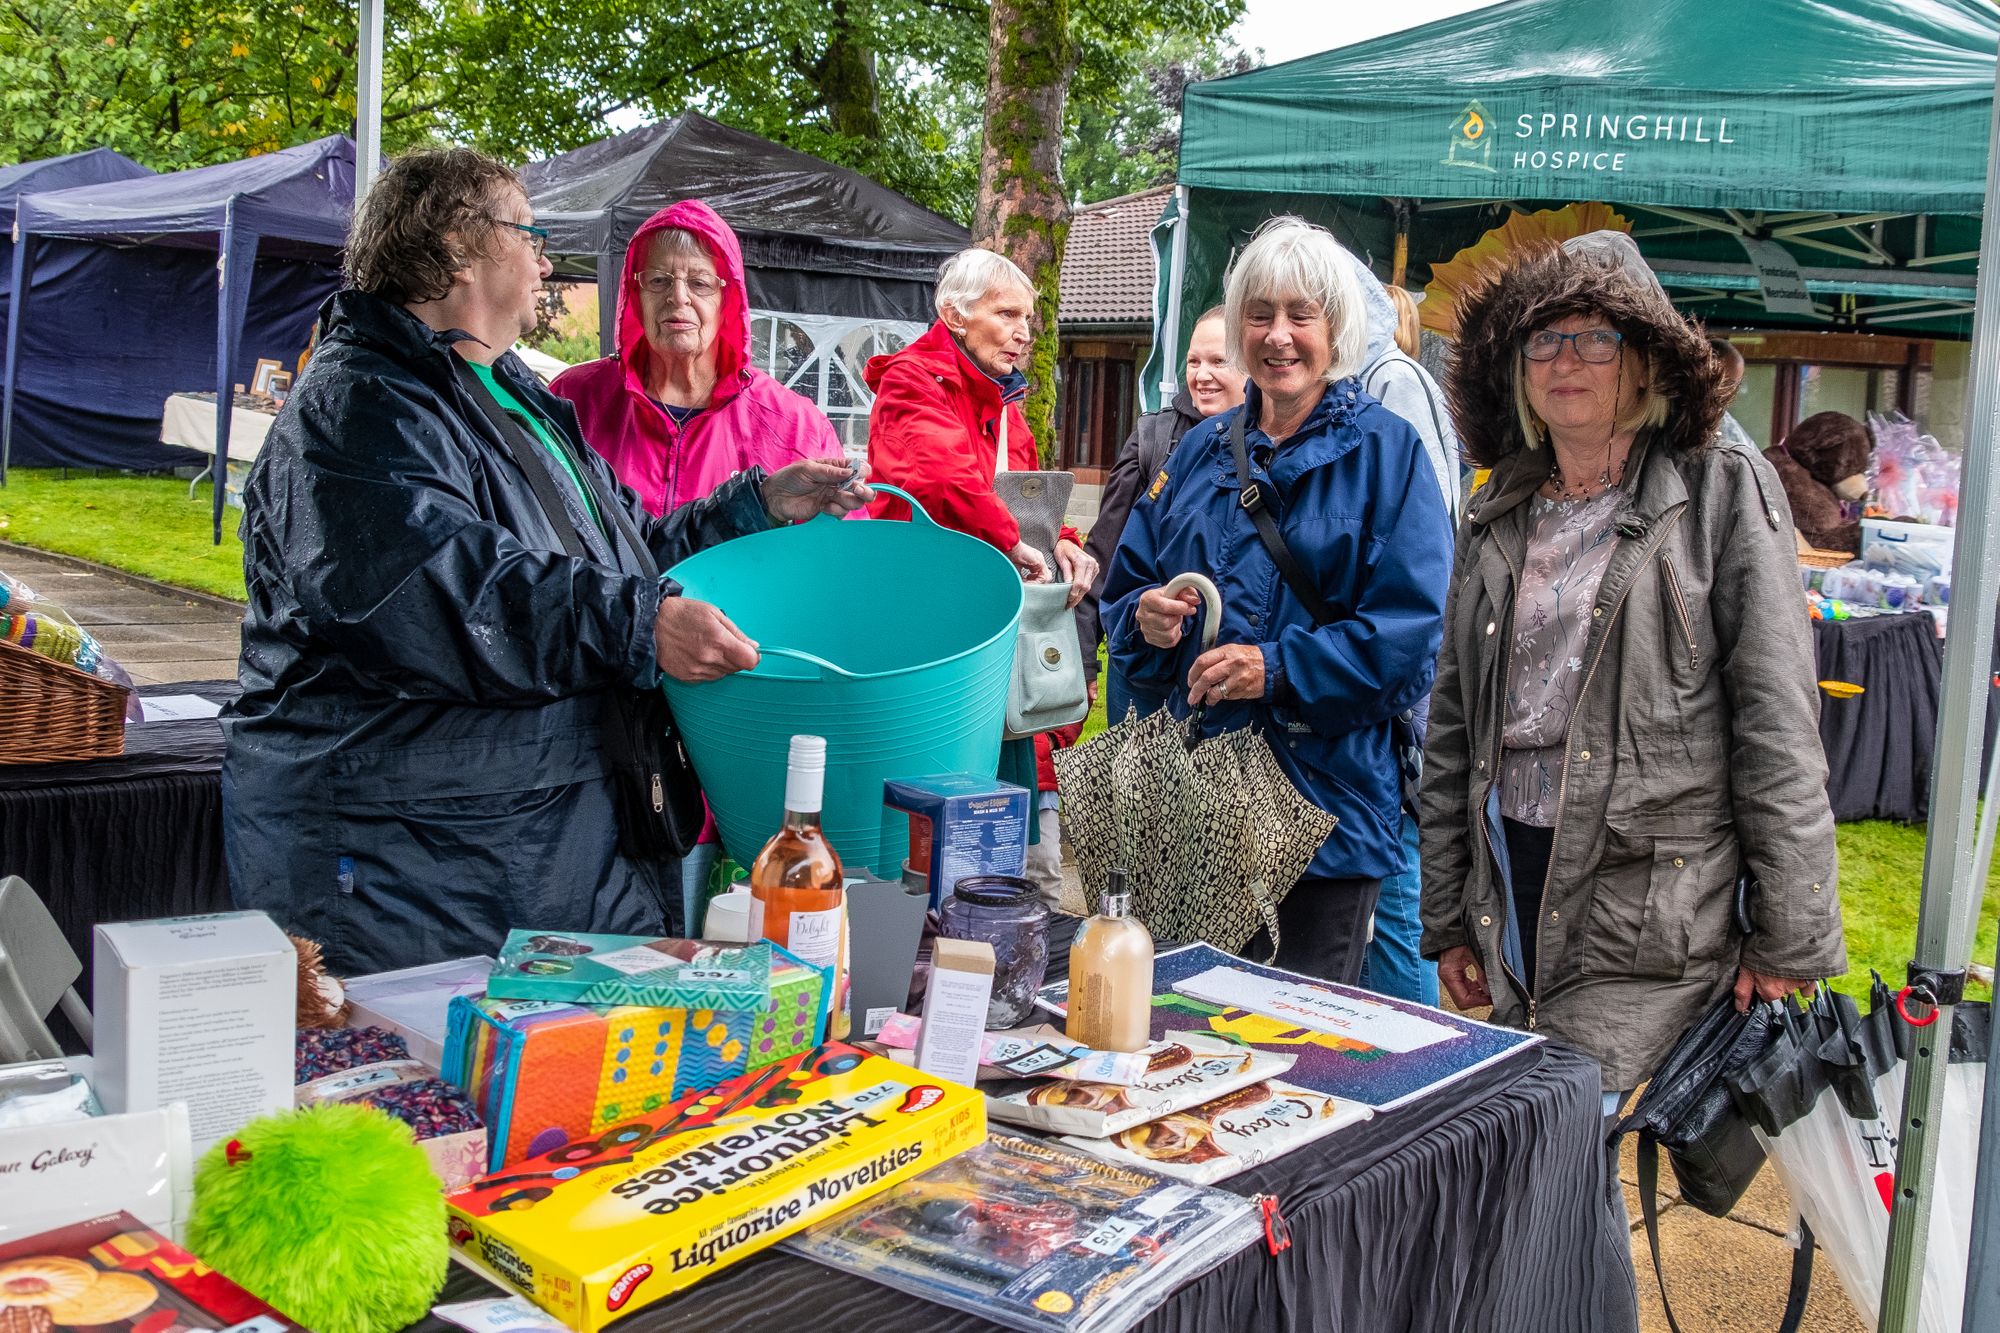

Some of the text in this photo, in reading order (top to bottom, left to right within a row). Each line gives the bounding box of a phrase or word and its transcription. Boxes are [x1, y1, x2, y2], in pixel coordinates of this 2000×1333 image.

[1515, 113, 1735, 143] SPRINGHILL
[1513, 151, 1626, 171] HOSPICE
[692, 970, 738, 979] 765
[1268, 999, 1352, 1029] Tombola
[1314, 999, 1359, 1016] tickets
[1018, 1054, 1050, 1068] 755
[854, 1085, 895, 1103] 710
[905, 1088, 944, 1113] Barratt
[949, 1107, 971, 1130] KIDS
[1219, 1099, 1313, 1137] Glaxy
[611, 1098, 854, 1199] Novelties
[805, 1147, 831, 1163] your
[833, 1140, 850, 1150] All
[31, 1147, 96, 1173] Galaxy
[643, 1112, 887, 1215] Liquorice
[670, 1140, 923, 1273] Liquorice Novelties
[1092, 1224, 1125, 1246] 705
[478, 1230, 533, 1278] Liquorice
[480, 1245, 535, 1294] Novelties
[609, 1264, 650, 1302] Barratt
